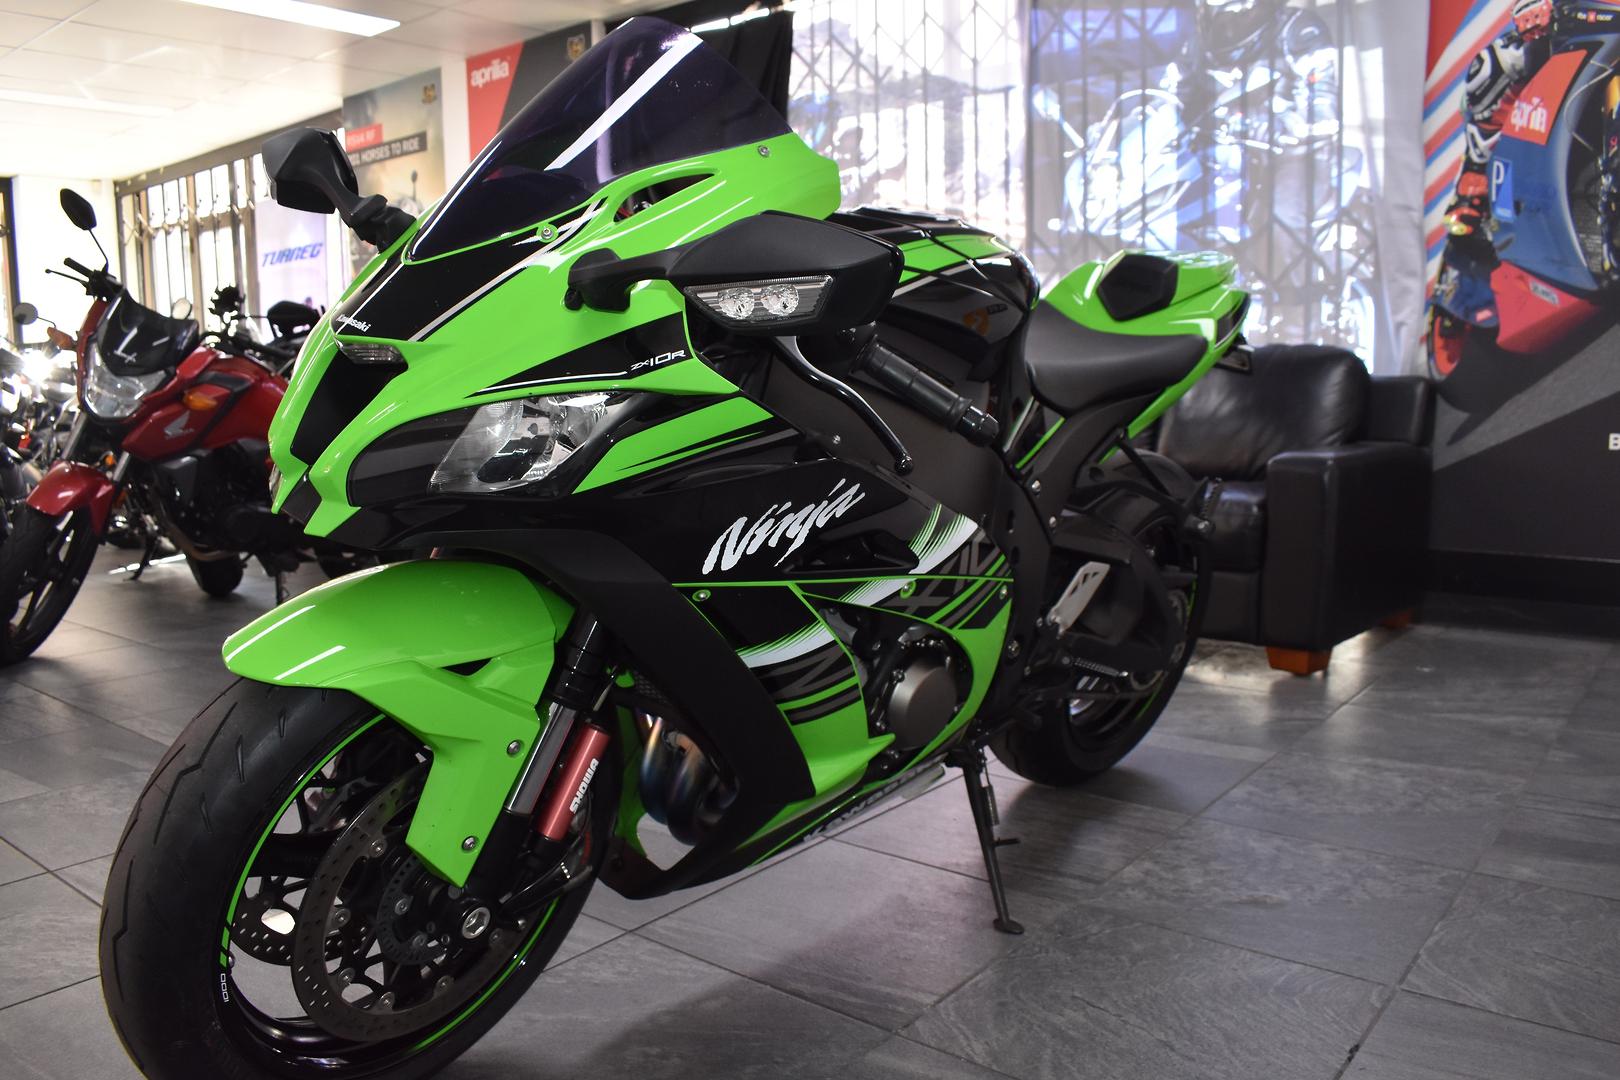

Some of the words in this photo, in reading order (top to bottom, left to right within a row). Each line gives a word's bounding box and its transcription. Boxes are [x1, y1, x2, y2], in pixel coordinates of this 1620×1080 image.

[470, 60, 510, 88] aprilia
[402, 137, 420, 152] RIDE
[702, 478, 866, 575] Ninja
[569, 758, 599, 814] SHOWA
